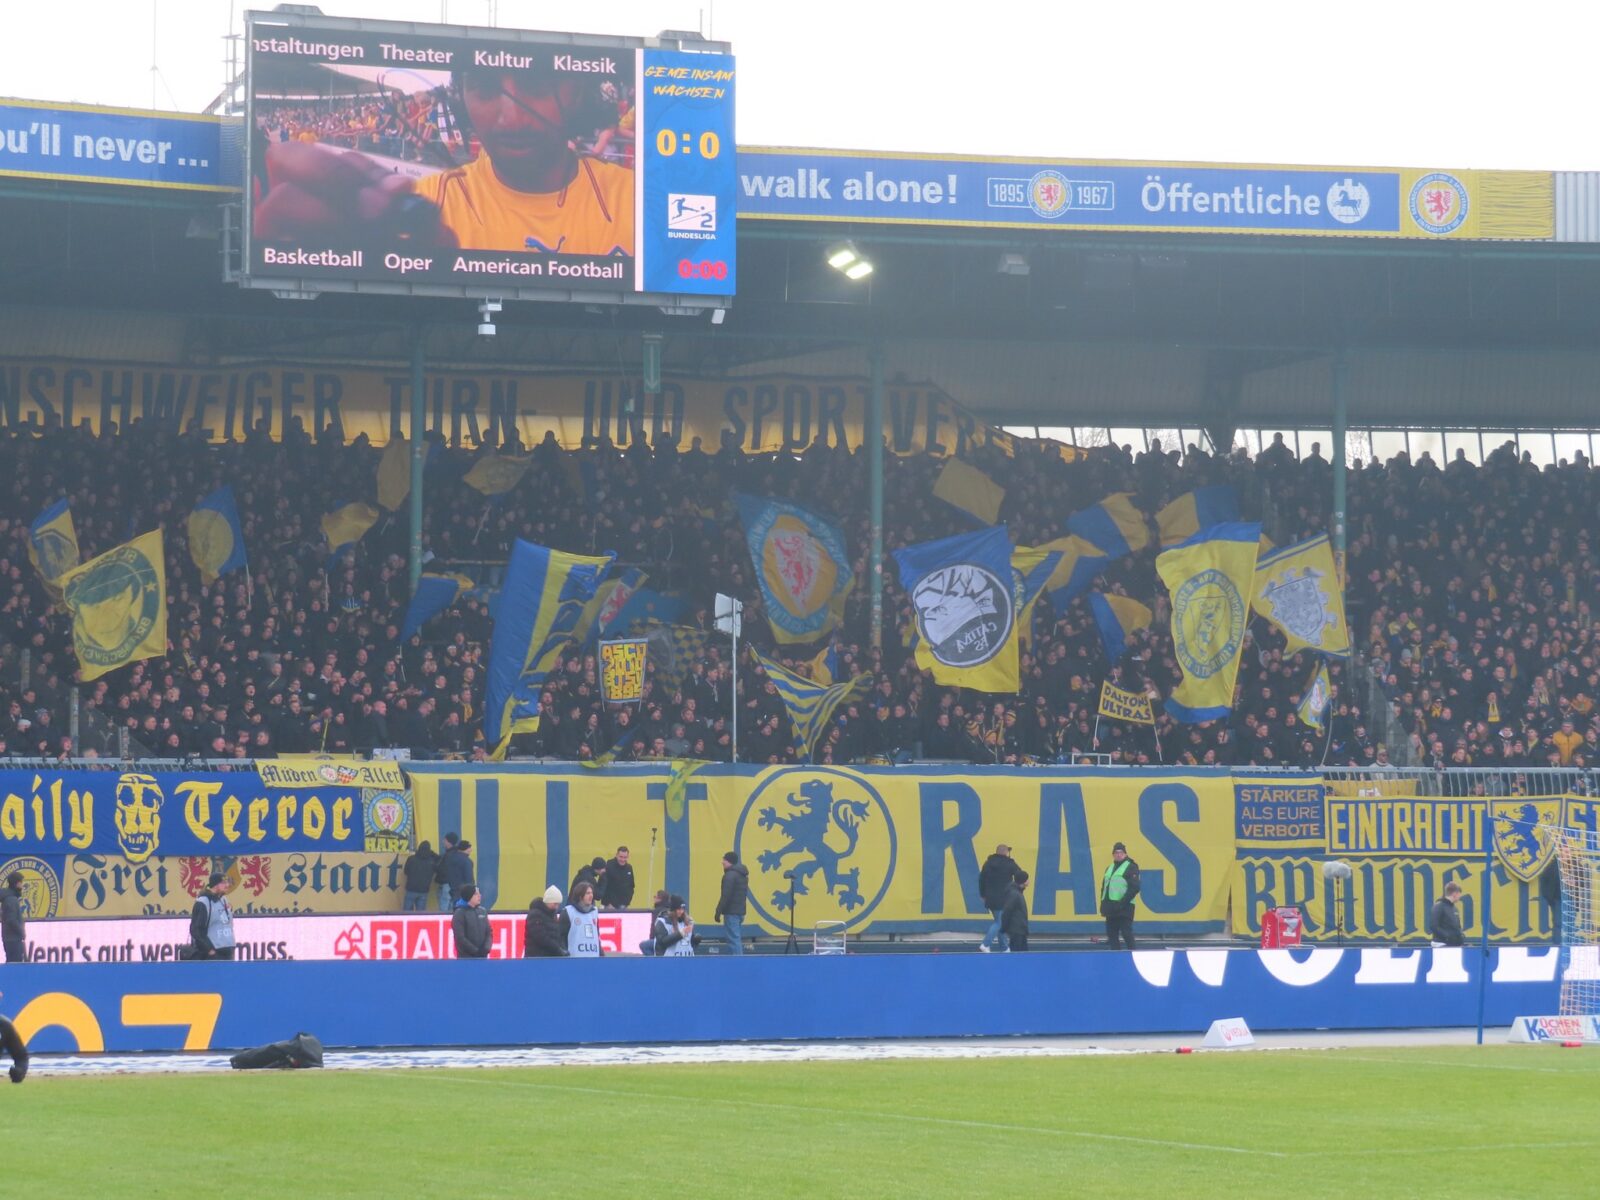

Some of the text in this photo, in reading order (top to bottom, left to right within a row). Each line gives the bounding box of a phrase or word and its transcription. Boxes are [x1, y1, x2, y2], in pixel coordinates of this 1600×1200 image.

[379, 43, 454, 64] Theater
[474, 49, 534, 70] Kultur
[553, 55, 617, 75] Klassik
[644, 65, 736, 82] GEMEINSAM
[653, 84, 725, 99] WACHSEN
[0, 121, 61, 156] u'll
[73, 134, 172, 164] never
[740, 168, 957, 205] walk alone!
[993, 183, 1024, 203] 1895
[1077, 185, 1108, 206] 1967
[1141, 175, 1321, 217] Öffentliche
[668, 231, 716, 240] BUNDESLIGA
[263, 247, 623, 279] Basketball Oper American Football
[678, 258, 728, 281] 0:00
[1103, 698, 1151, 720] ULTRAS
[263, 764, 318, 783] Müden
[1241, 786, 1318, 803] STÄRKER
[174, 782, 353, 843] Terror
[1242, 807, 1320, 820] ALS EURE
[1242, 824, 1320, 838] VERBOTE
[1330, 802, 1486, 850] EINTRACHT
[365, 836, 409, 853] HARZ
[72, 853, 169, 910] Frei
[283, 853, 401, 894] staat
[235, 941, 294, 961] muss.
